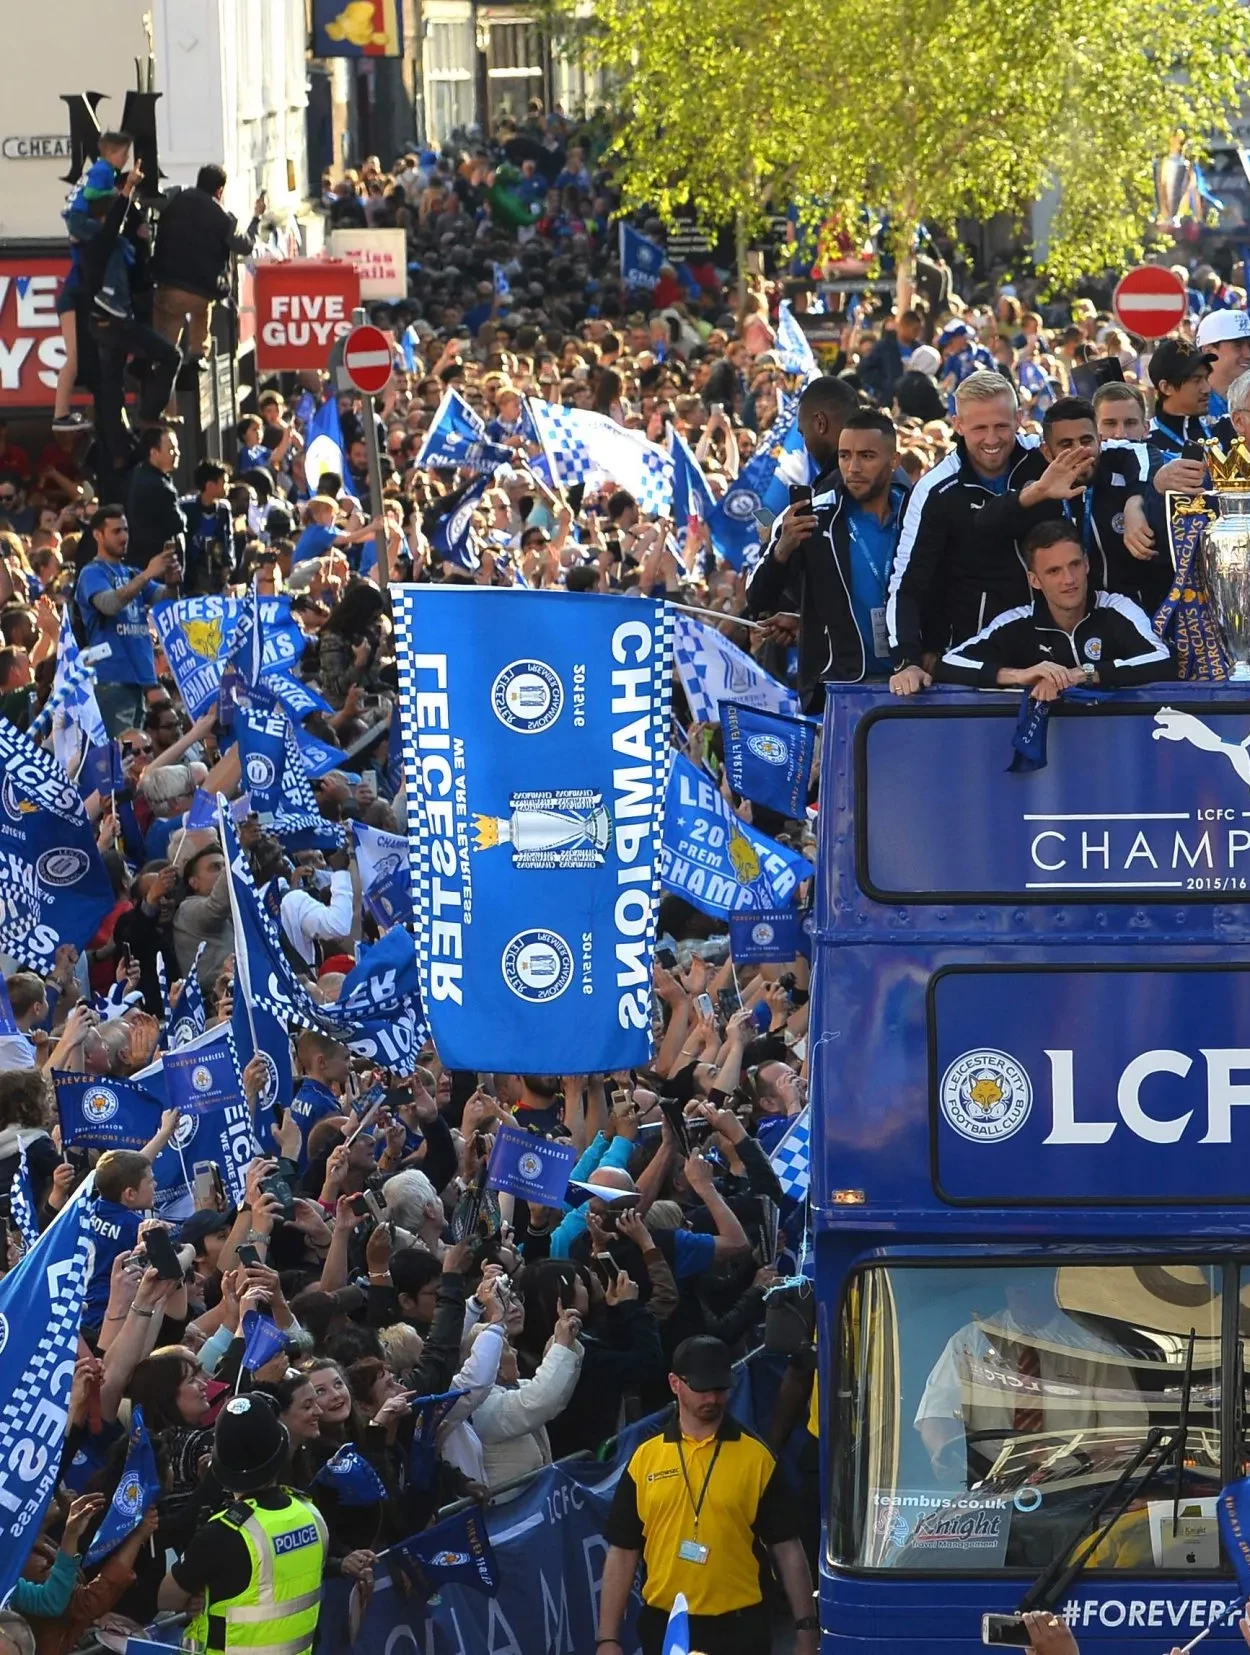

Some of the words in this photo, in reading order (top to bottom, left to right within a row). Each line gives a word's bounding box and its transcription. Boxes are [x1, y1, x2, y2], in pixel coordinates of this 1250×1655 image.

[271, 296, 344, 320] FIVE
[1175, 518, 1204, 586] BARCLAYS
[1197, 808, 1235, 821] LCFC
[689, 818, 726, 848] 20
[677, 839, 723, 868] PREM
[1186, 877, 1247, 890] 2015/16
[198, 1051, 226, 1063] FEARLESS
[948, 1056, 1006, 1092] LEICESTER
[1005, 1066, 1025, 1092] CITY
[948, 1099, 1002, 1135] FOOTBALL
[1002, 1099, 1025, 1129] CLUB
[219, 1131, 229, 1152] WE
[224, 1155, 237, 1180] ARE
[534, 1145, 570, 1161] FEARLESS
[873, 1494, 1007, 1510] teambus.co.uk
[913, 1510, 1001, 1541] Knight
[274, 1526, 319, 1554] POLICE
[911, 1540, 937, 1549] Travel
[937, 1540, 999, 1550] Management
